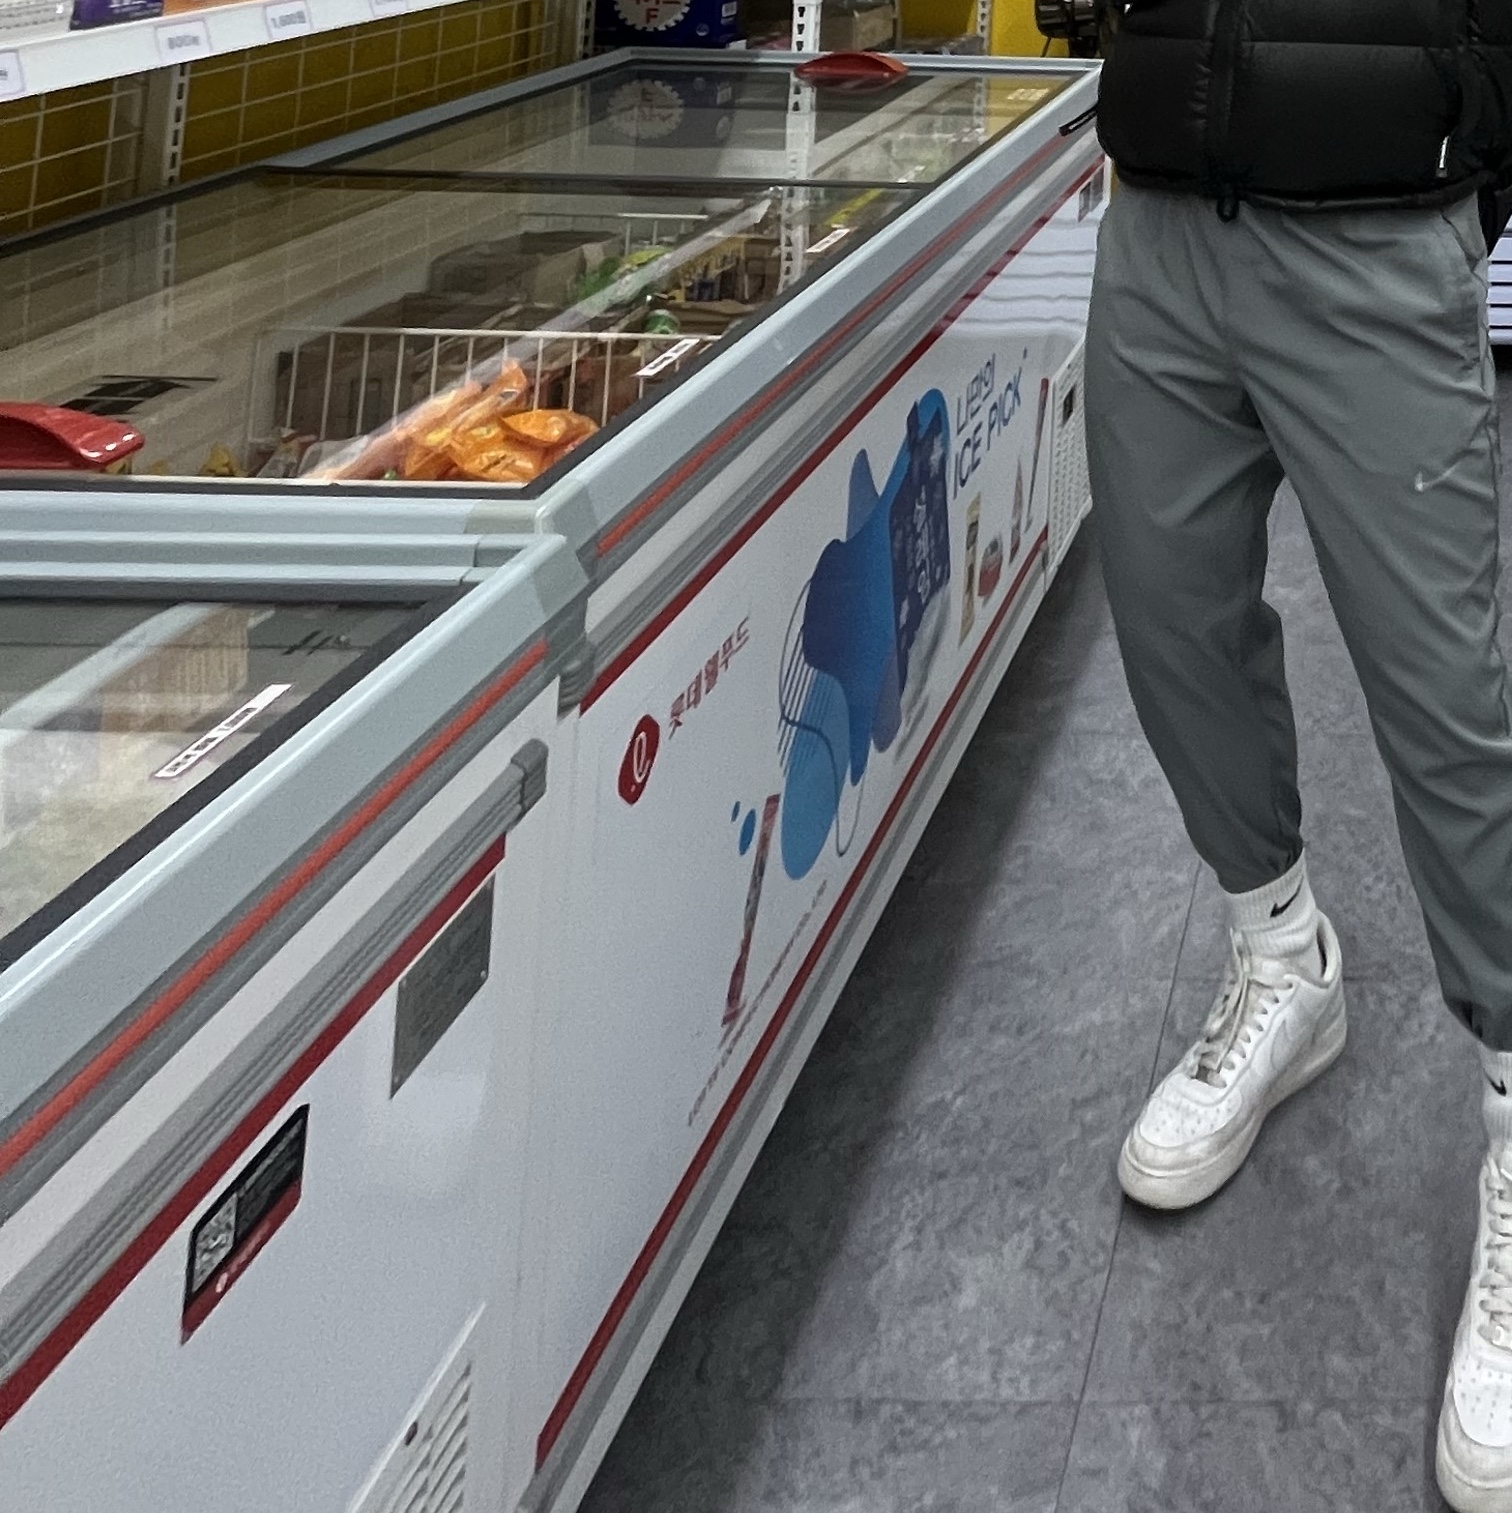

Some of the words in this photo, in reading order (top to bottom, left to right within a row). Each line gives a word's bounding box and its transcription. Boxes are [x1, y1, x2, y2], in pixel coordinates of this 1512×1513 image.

[645, 7, 658, 23] F
[952, 421, 983, 501] ICE
[987, 365, 1023, 452] PICK
